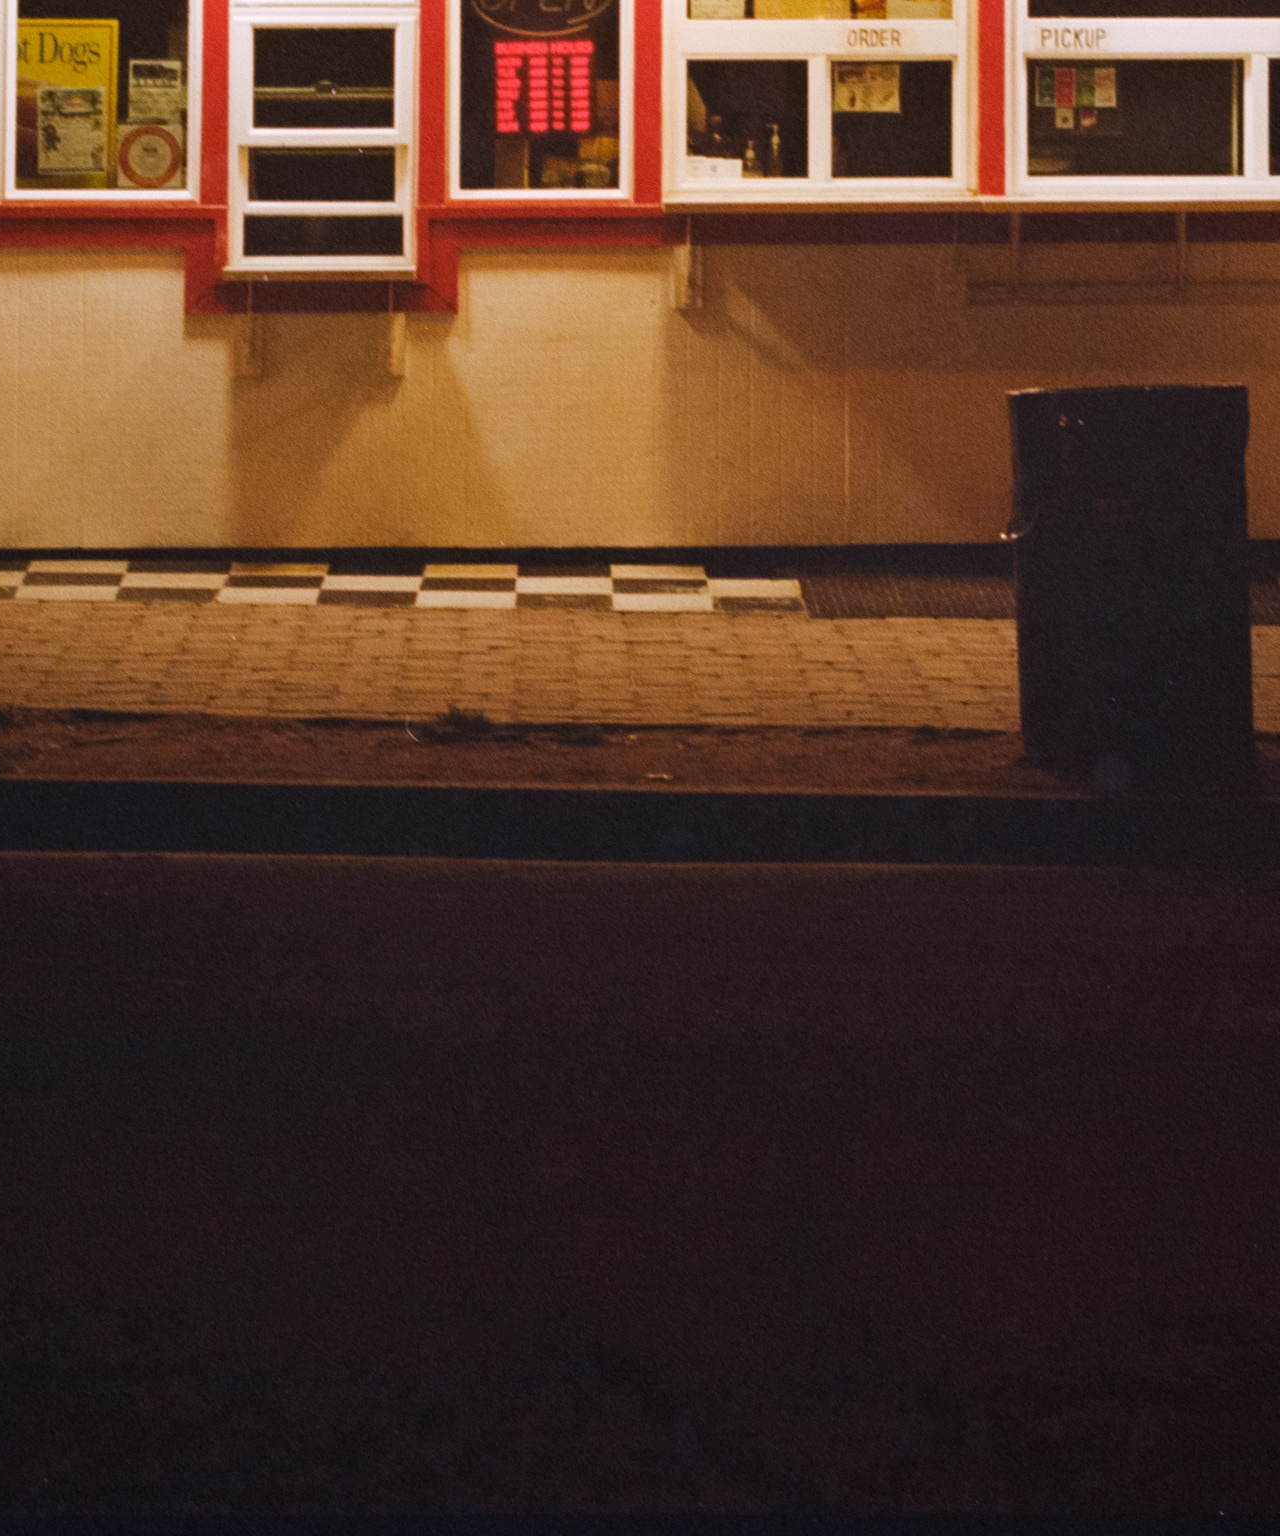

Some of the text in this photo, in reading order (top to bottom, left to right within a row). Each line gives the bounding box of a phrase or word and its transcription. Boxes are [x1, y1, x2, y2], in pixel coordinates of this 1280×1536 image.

[847, 28, 902, 48] ORDER
[1040, 27, 1107, 49] PICKUP
[39, 31, 101, 74] Dogs
